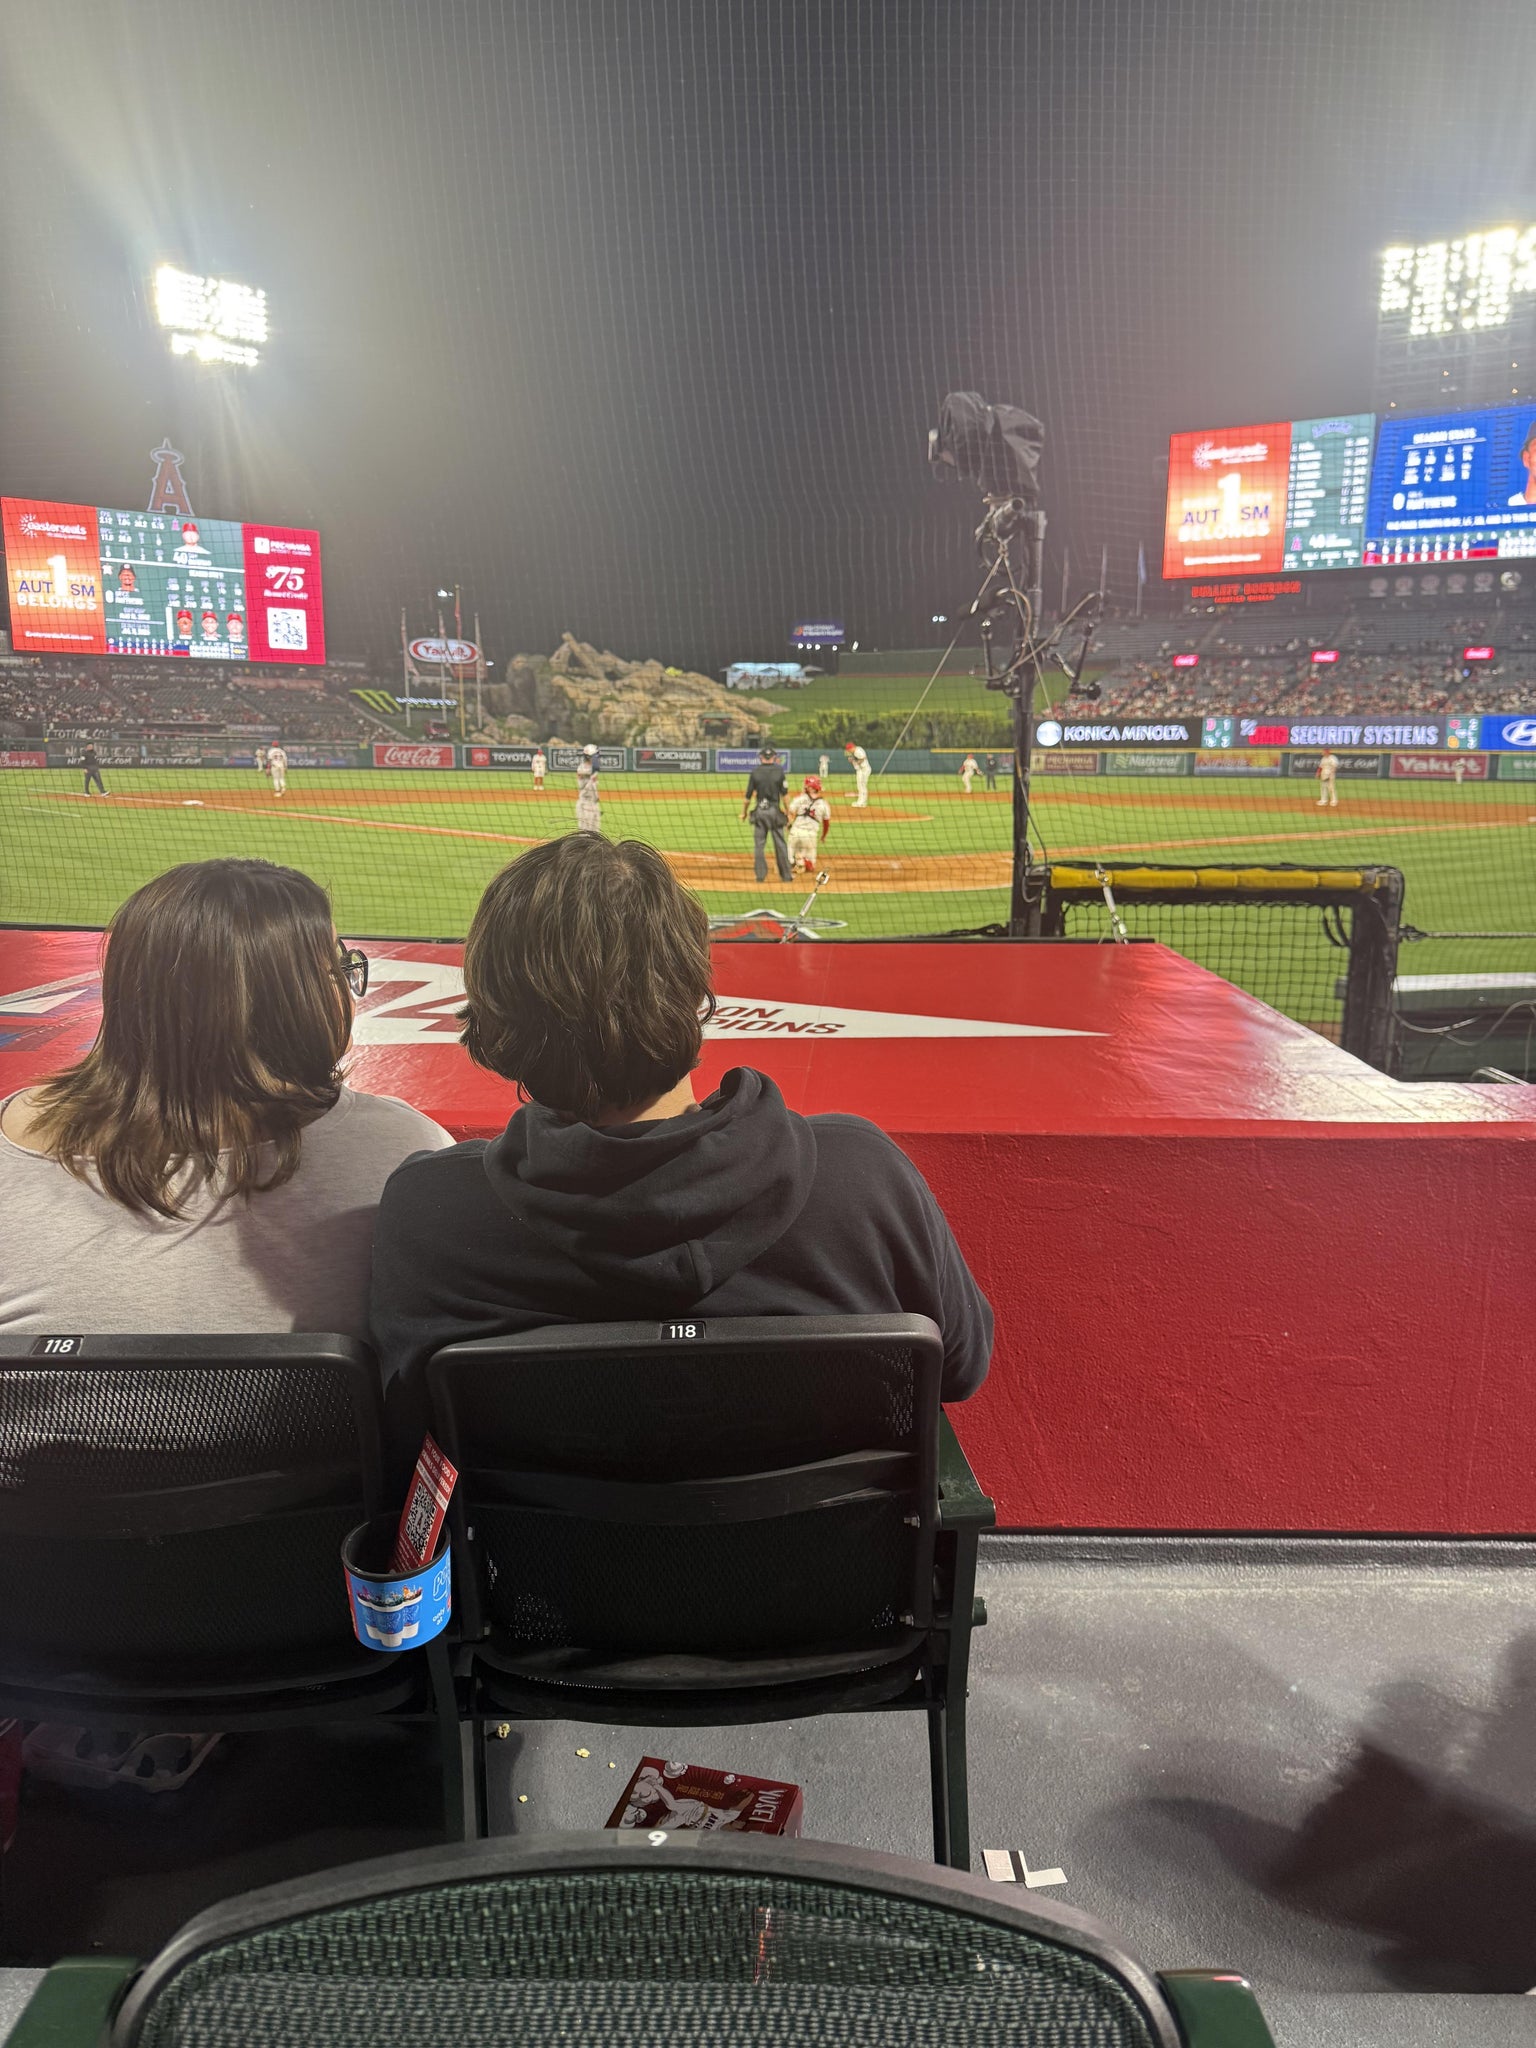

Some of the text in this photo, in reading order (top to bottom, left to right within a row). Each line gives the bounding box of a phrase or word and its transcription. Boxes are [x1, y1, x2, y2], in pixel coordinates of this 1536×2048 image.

[265, 565, 305, 592] $75
[17, 593, 98, 611] BELONGS
[1064, 725, 1121, 742] KONICA
[1121, 724, 1190, 741] MINOLTA
[1290, 725, 1362, 745] SECURITY
[1364, 725, 1439, 745] SYSTEMS
[492, 752, 532, 763] TOYOTA
[655, 751, 701, 760] YOKOHAMA
[720, 756, 761, 765] Memorial
[669, 1325, 696, 1339] 118
[44, 1339, 75, 1354] 118
[647, 1830, 668, 1847] 9
